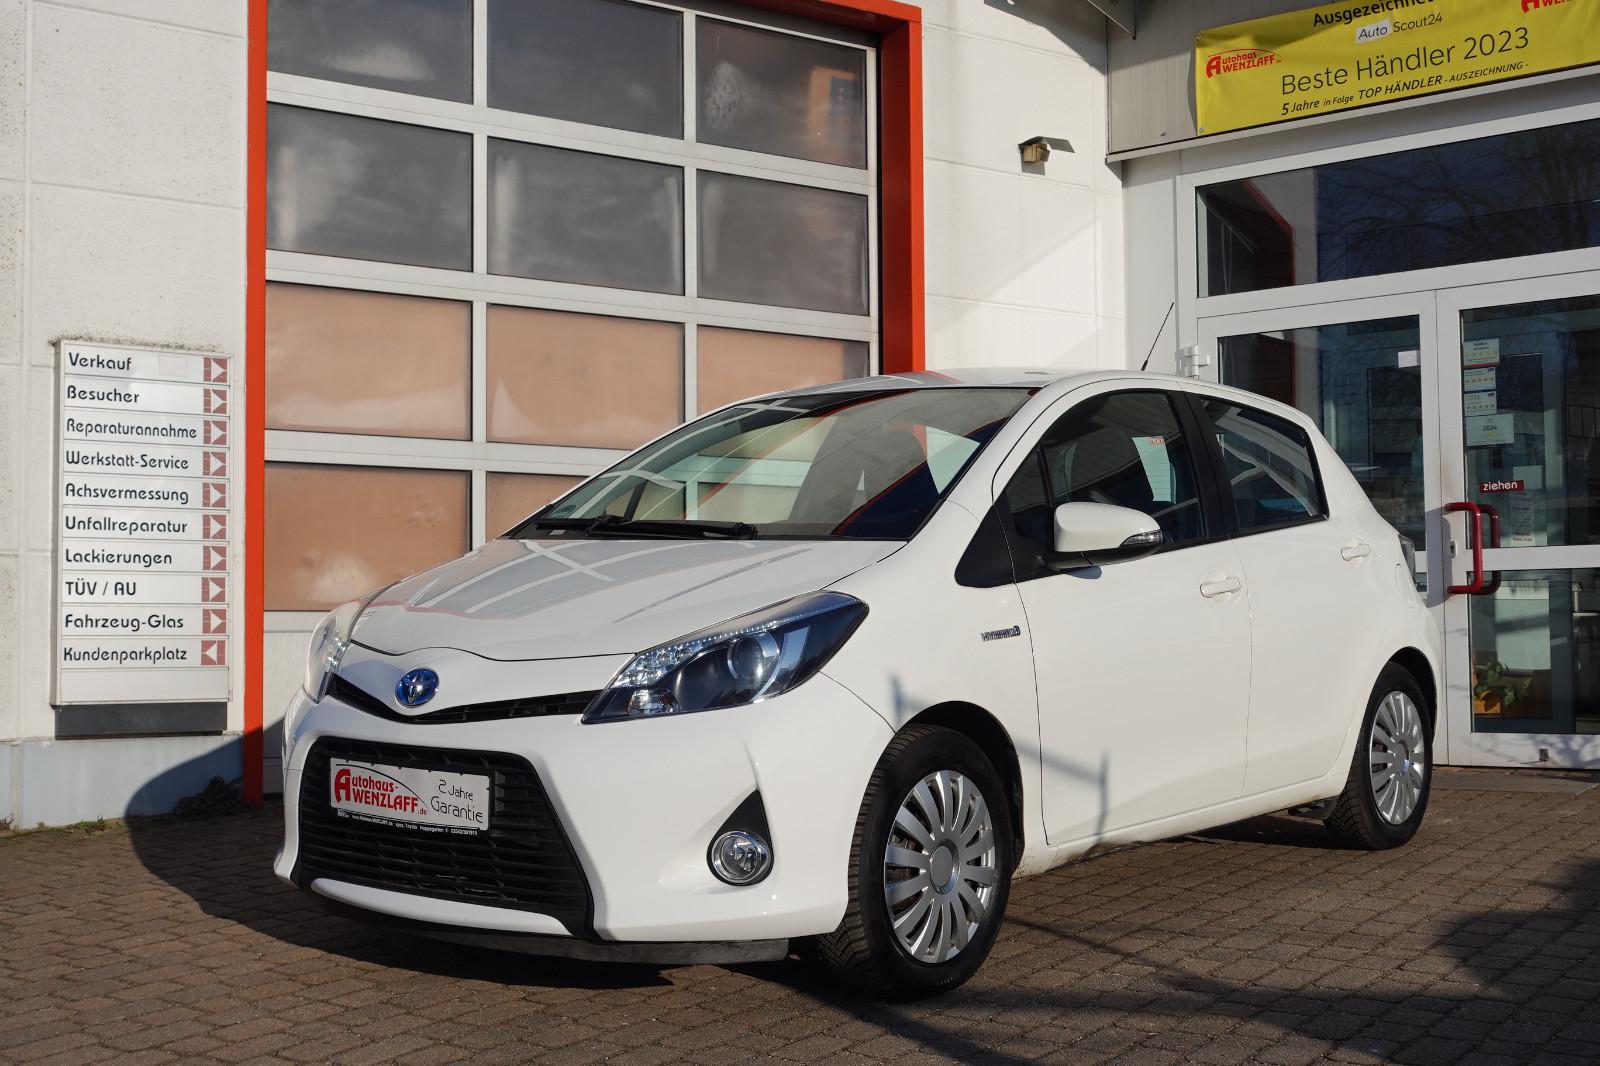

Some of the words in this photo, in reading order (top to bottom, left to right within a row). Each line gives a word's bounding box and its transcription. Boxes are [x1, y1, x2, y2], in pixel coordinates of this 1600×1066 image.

[1206, 52, 1257, 78] Autohaus
[1222, 55, 1275, 73] WENZLAFF
[1282, 67, 1348, 95] Beste
[1357, 45, 1456, 81] Händler
[1463, 26, 1529, 60] 2023
[1281, 102, 1289, 116] 5
[1291, 99, 1320, 113] Jahre
[1323, 98, 1331, 106] in
[1332, 95, 1354, 105] Folge
[1358, 86, 1382, 100] TOP
[1384, 74, 1443, 95] HÄNDLER
[1449, 61, 1524, 83] AUSZEICHNUNG
[68, 352, 132, 371] Verkauf
[67, 385, 140, 403] Besucher
[66, 418, 197, 439] Reparaturannahme
[66, 450, 189, 469] Werkstatt-Service
[65, 483, 189, 505] Achsvermessung
[1483, 480, 1518, 491] ziehen
[65, 516, 188, 535] Unfallreparatur
[65, 548, 172, 567] Lackierungen
[65, 578, 98, 596] TÜV
[102, 581, 109, 596] /
[114, 581, 136, 596] AU
[65, 613, 184, 632] Fahrzeug-Glas
[63, 647, 187, 664] Kundenparkplatz
[438, 779, 447, 794] 2
[449, 785, 474, 801] Jahre
[352, 788, 419, 813] WENZLAFF
[430, 795, 483, 824] Garantie
